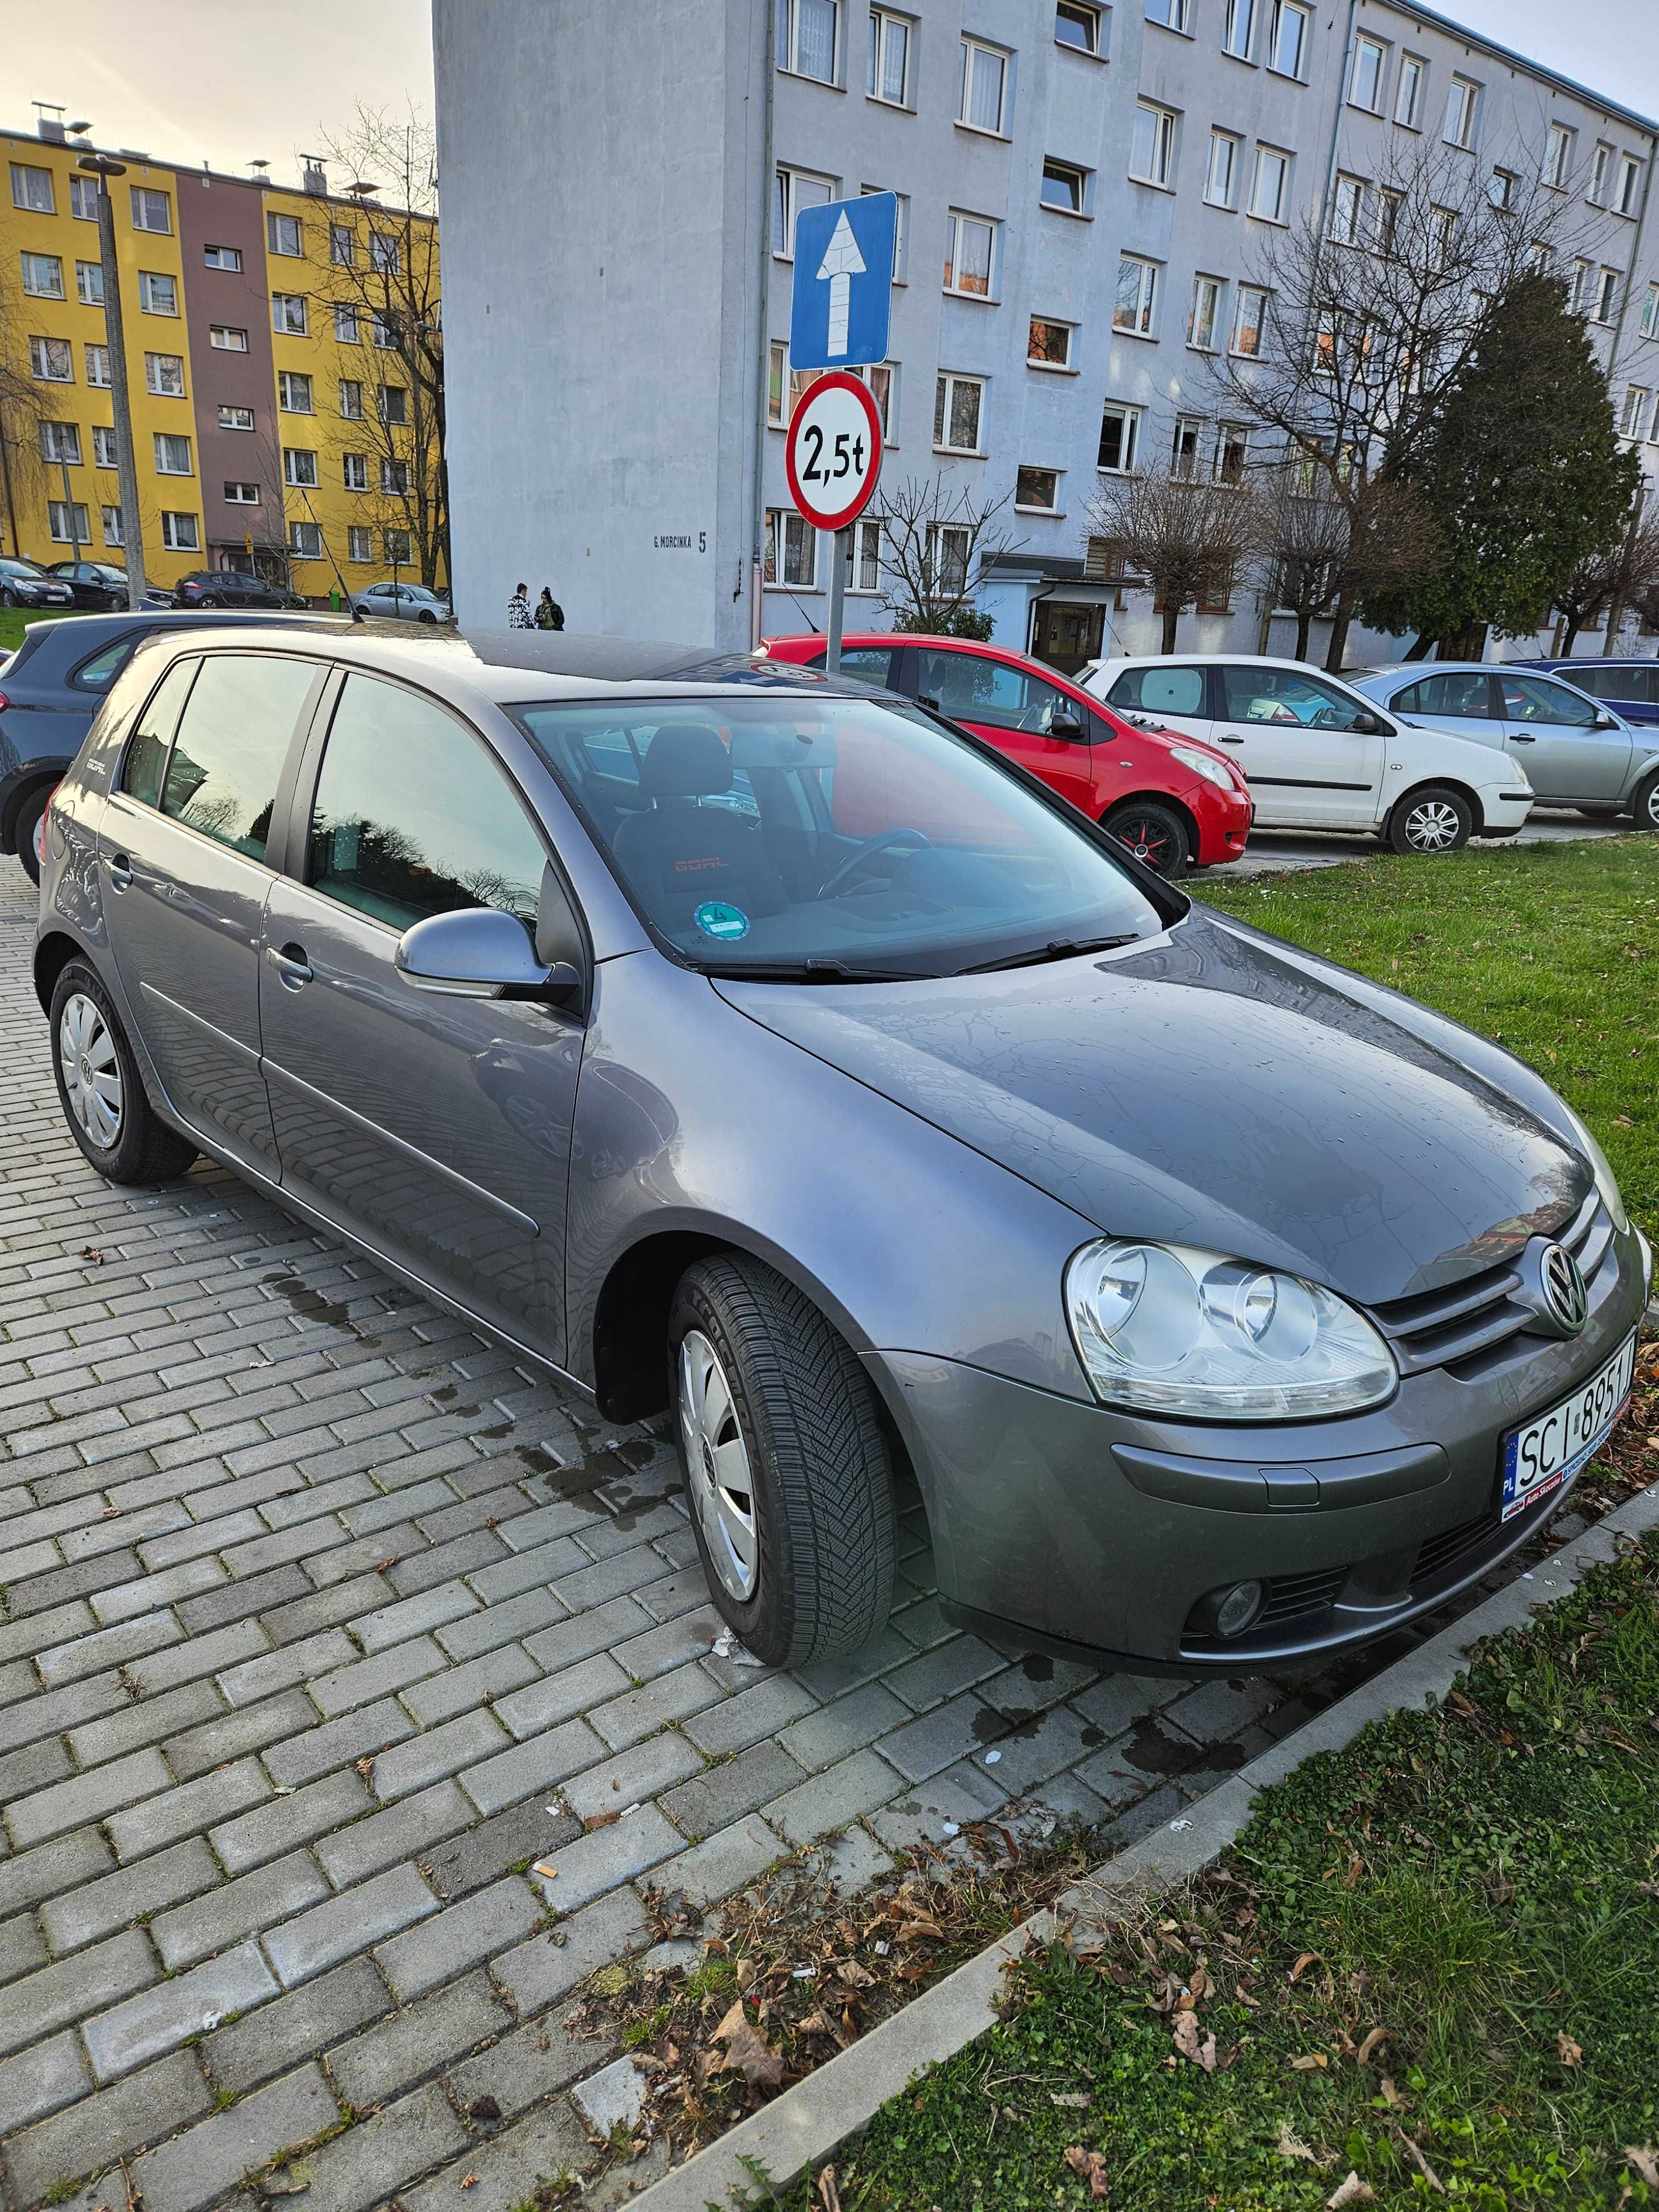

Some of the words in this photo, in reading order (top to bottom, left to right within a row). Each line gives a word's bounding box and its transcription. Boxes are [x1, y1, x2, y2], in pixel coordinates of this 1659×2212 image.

[803, 425, 864, 488] 2,5t
[698, 531, 707, 554] 5
[1520, 1406, 1570, 1486] SCI
[1582, 1342, 1632, 1442] 8951J
[1503, 1477, 1514, 1496] PL
[1526, 1492, 1539, 1506] Auto
